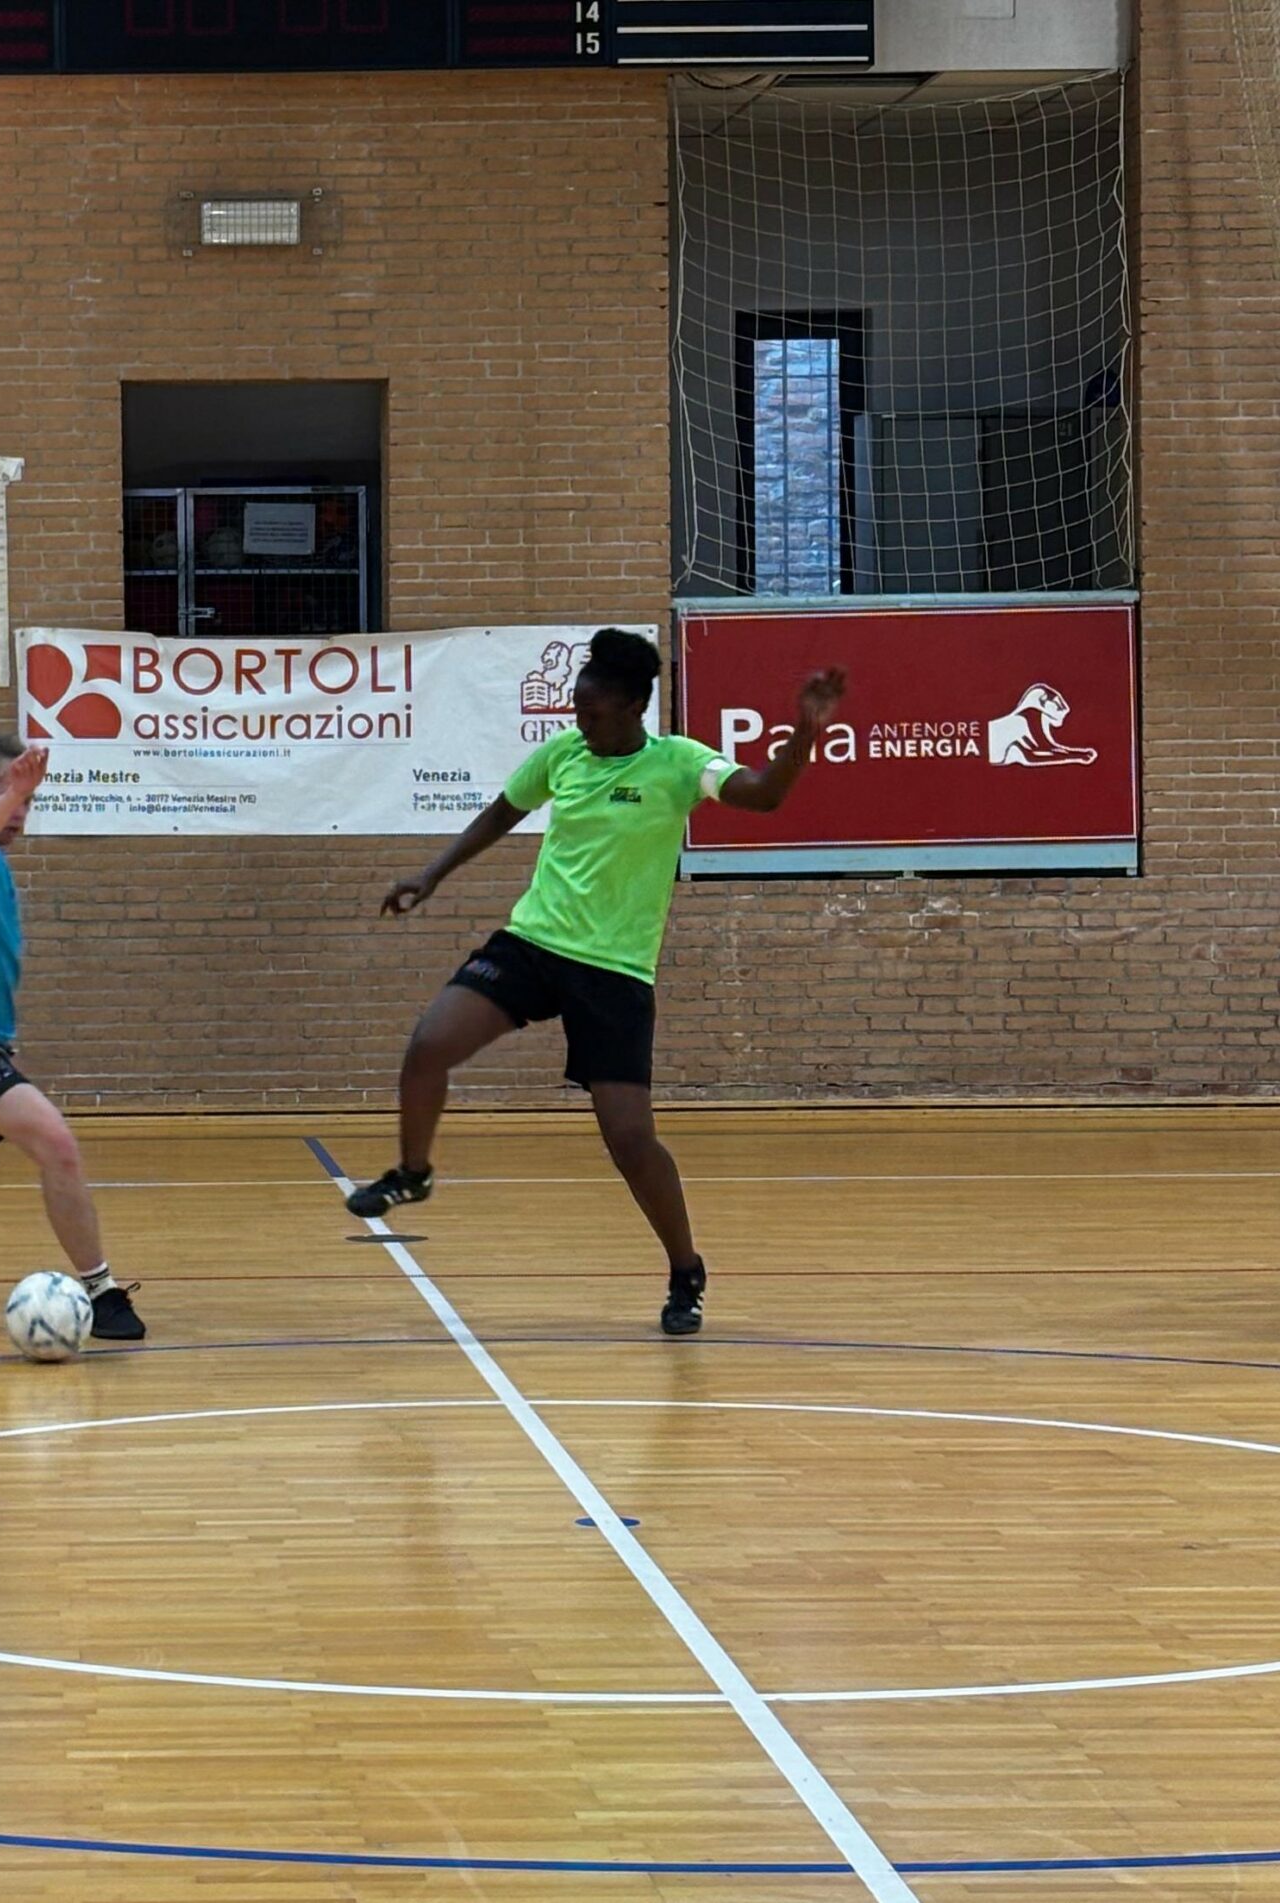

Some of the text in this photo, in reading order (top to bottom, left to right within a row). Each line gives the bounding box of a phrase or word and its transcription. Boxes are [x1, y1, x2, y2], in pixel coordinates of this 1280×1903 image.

[576, 1, 600, 23] 14
[576, 32, 600, 54] 15
[132, 644, 413, 696] BORTOLI
[133, 703, 413, 741] assicurazioni
[869, 721, 981, 738] ANTENORE
[133, 748, 292, 758] www.bortoliassicurazioni.it
[868, 738, 981, 758] ENERGIA
[44, 768, 141, 784] nezia Mestre
[412, 768, 471, 782] Venezia
